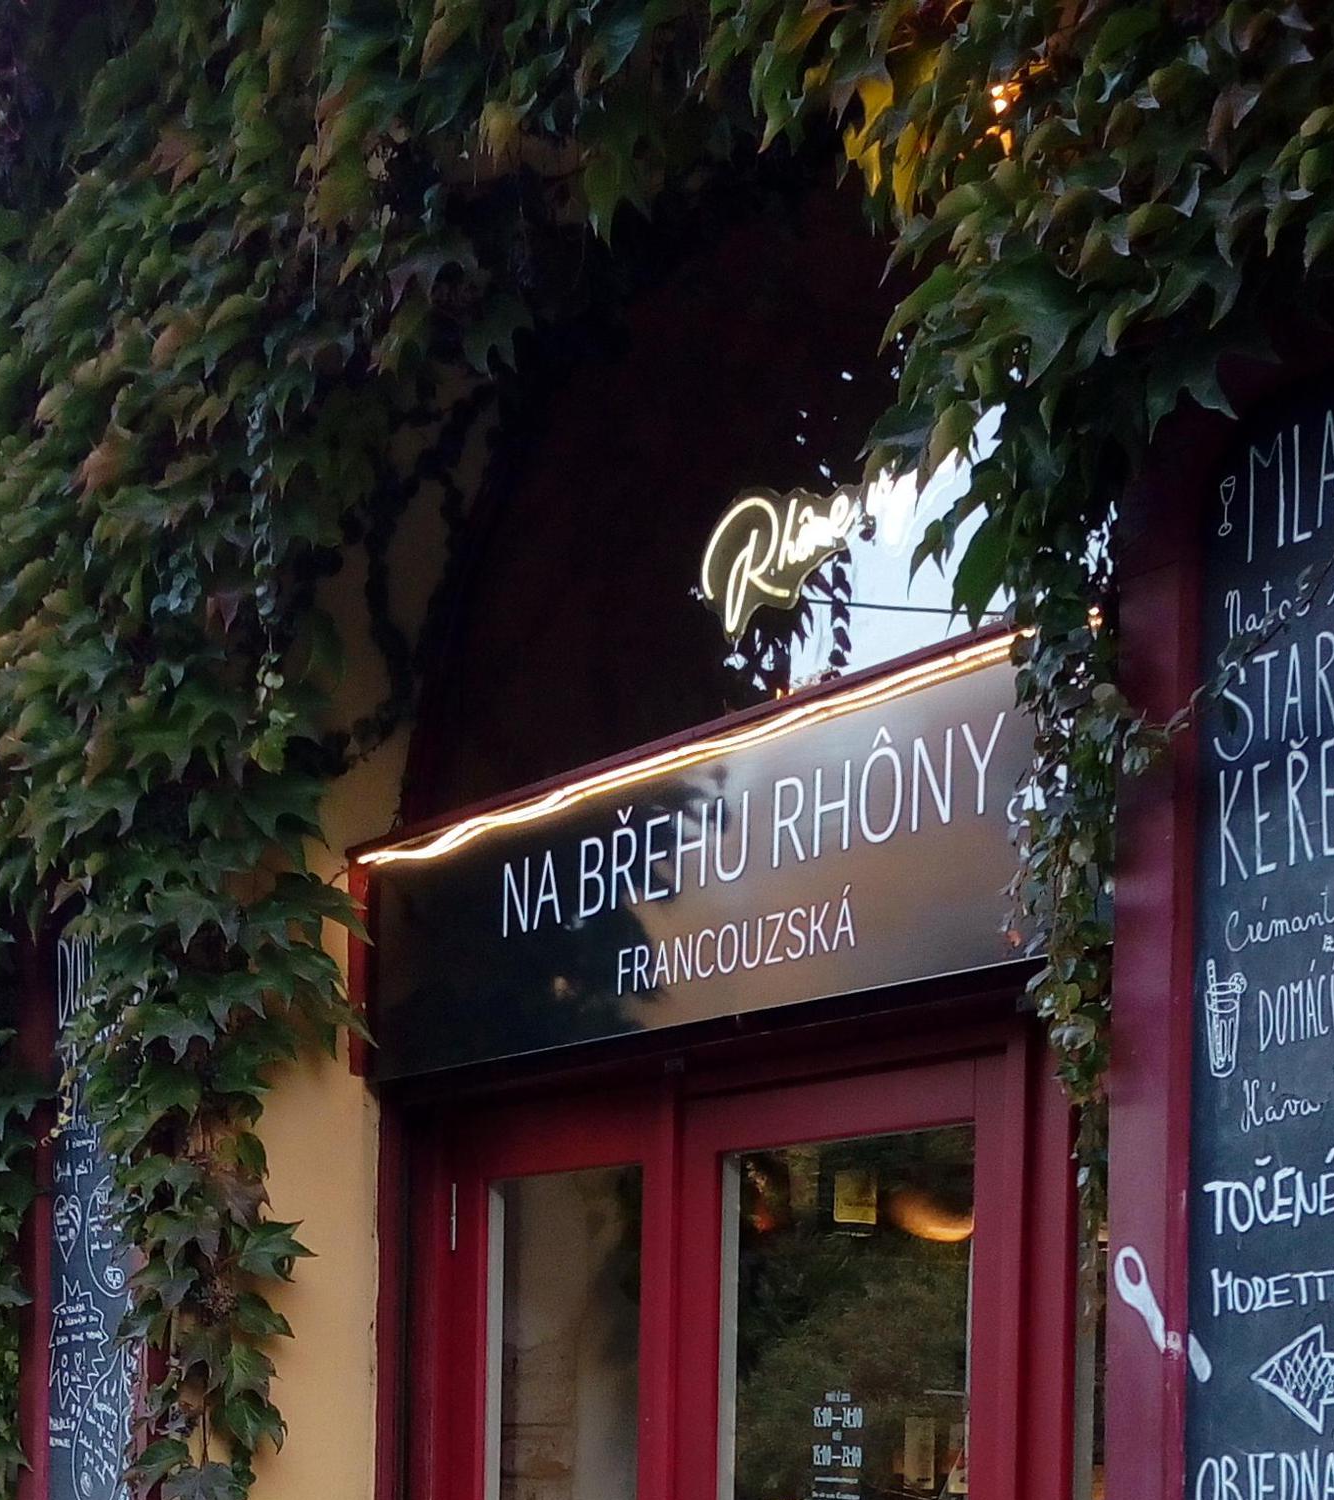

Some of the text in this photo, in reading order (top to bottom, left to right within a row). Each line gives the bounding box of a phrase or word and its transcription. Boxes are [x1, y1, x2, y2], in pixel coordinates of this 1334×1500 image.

[502, 712, 1007, 938] NA BŘEHU RHÔNY
[617, 883, 855, 997] FRANCOUZSKÁ
[1240, 1079, 1322, 1133] Káva
